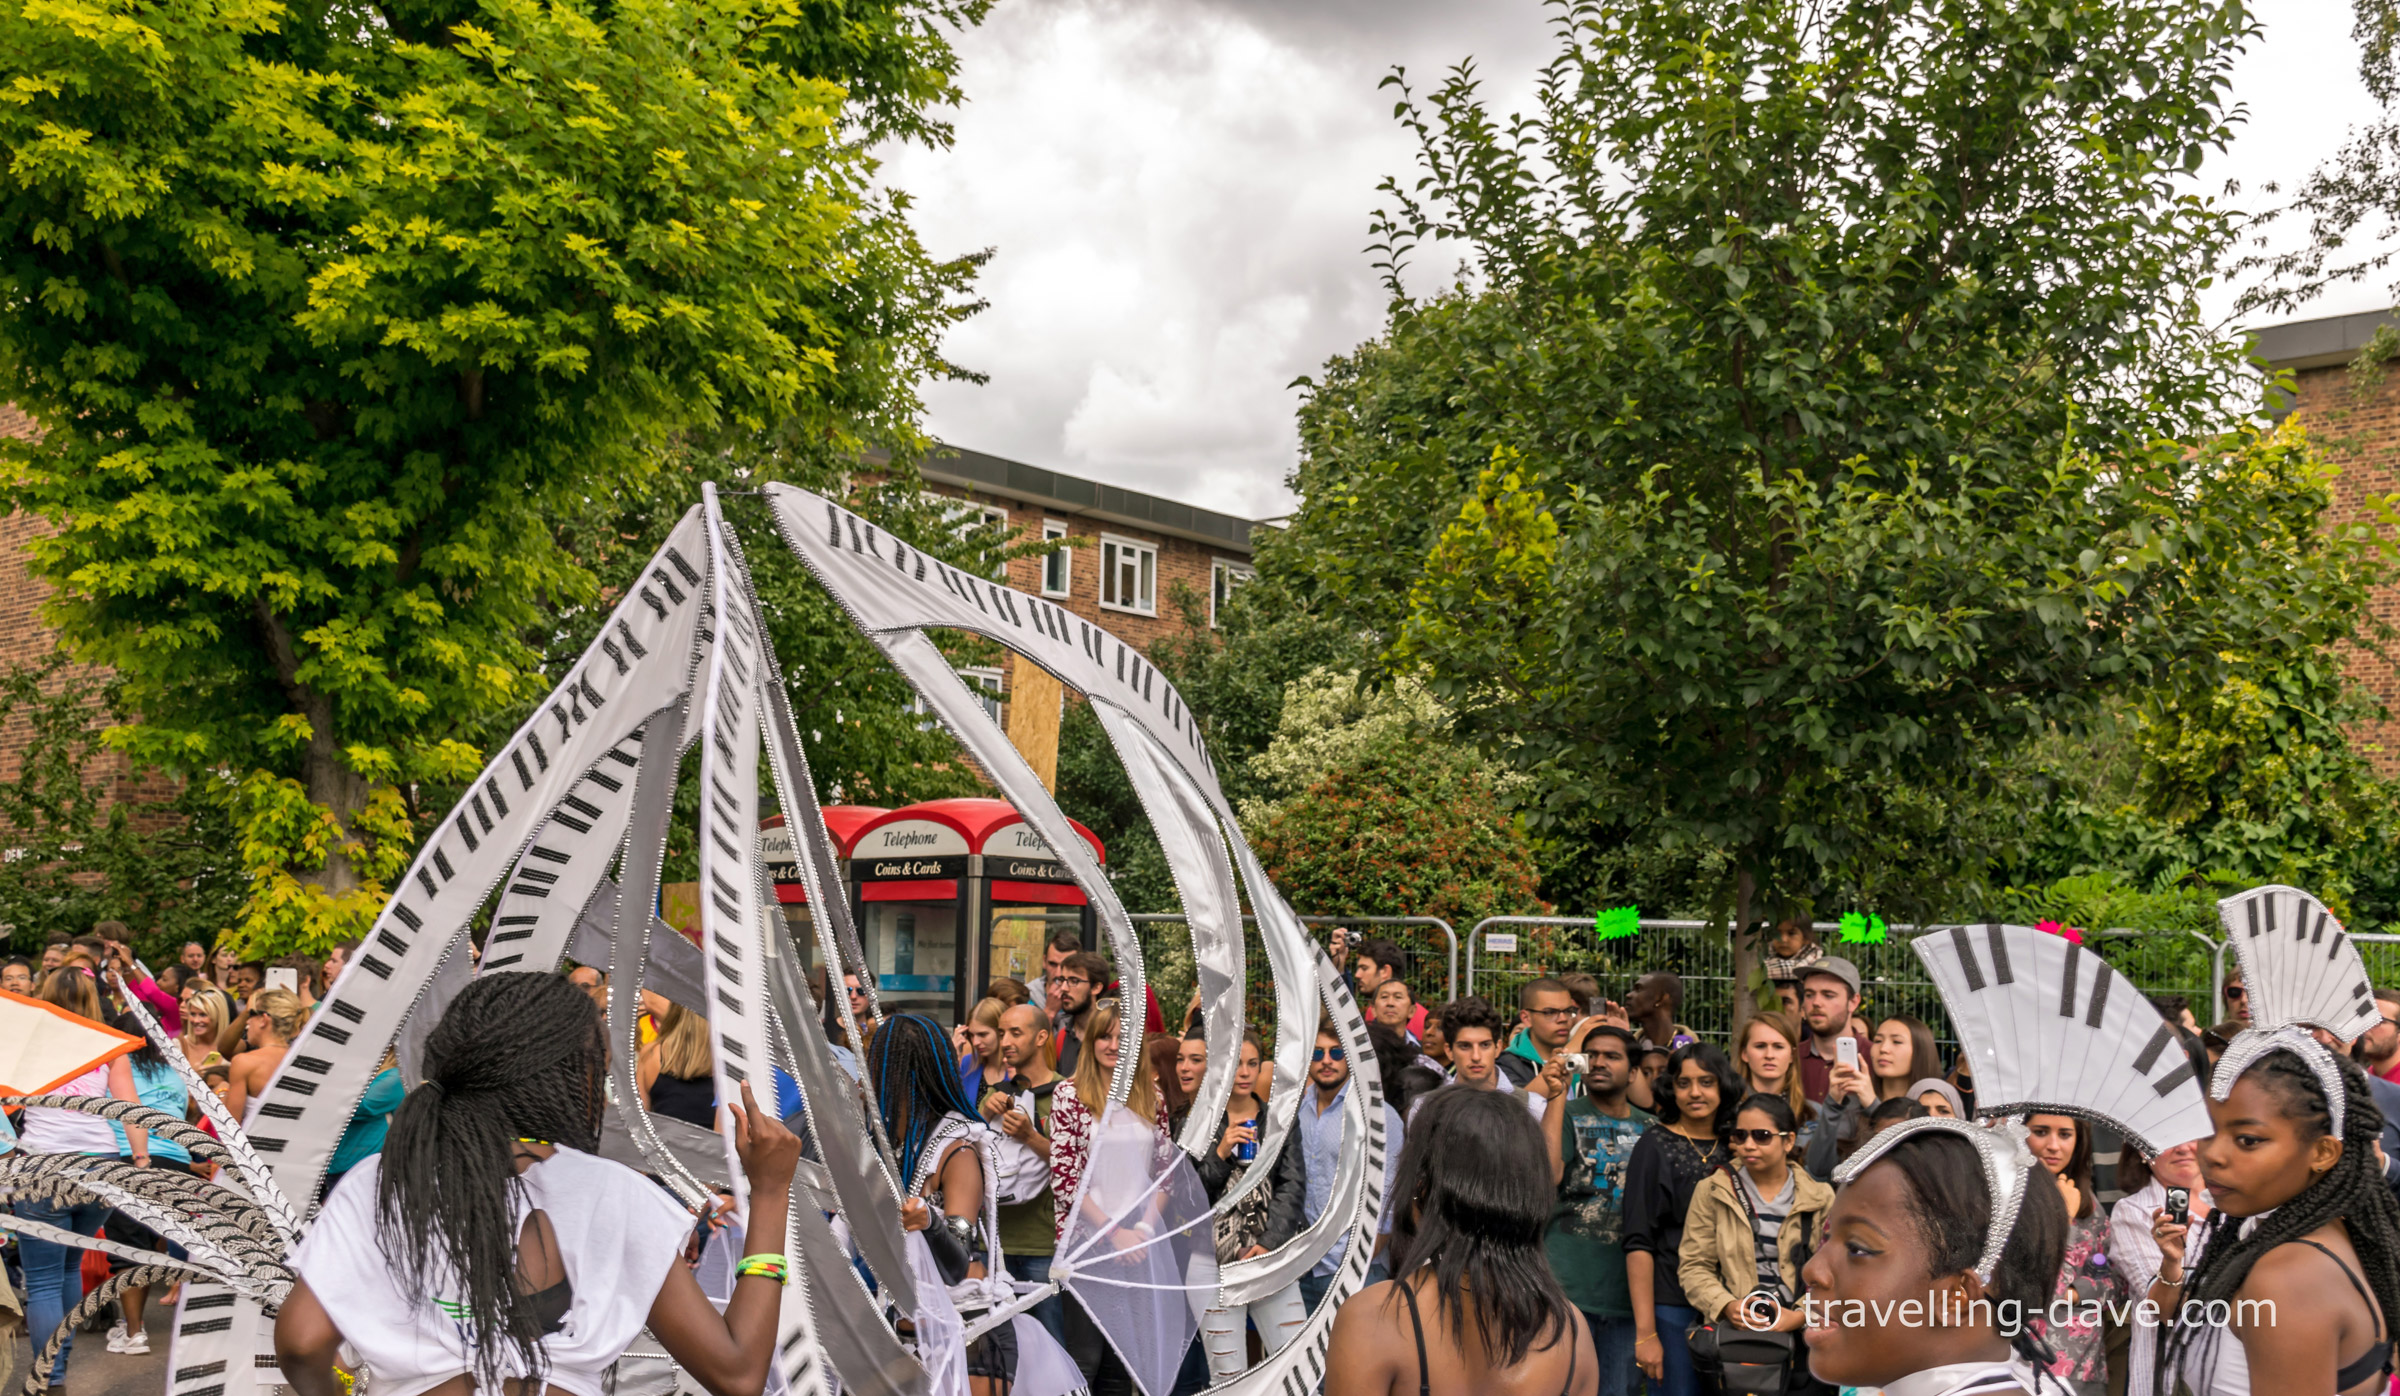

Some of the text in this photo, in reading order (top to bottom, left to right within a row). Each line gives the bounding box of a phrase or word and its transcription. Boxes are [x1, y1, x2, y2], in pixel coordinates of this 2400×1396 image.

[762, 836, 792, 855] Teleph
[884, 830, 938, 849] Telephone
[1016, 830, 1046, 851] Telep
[875, 860, 942, 876] Coins & Cards
[1010, 862, 1036, 876] Coins
[1037, 862, 1047, 878] &
[1737, 1189, 1751, 1216] DIGITAL
